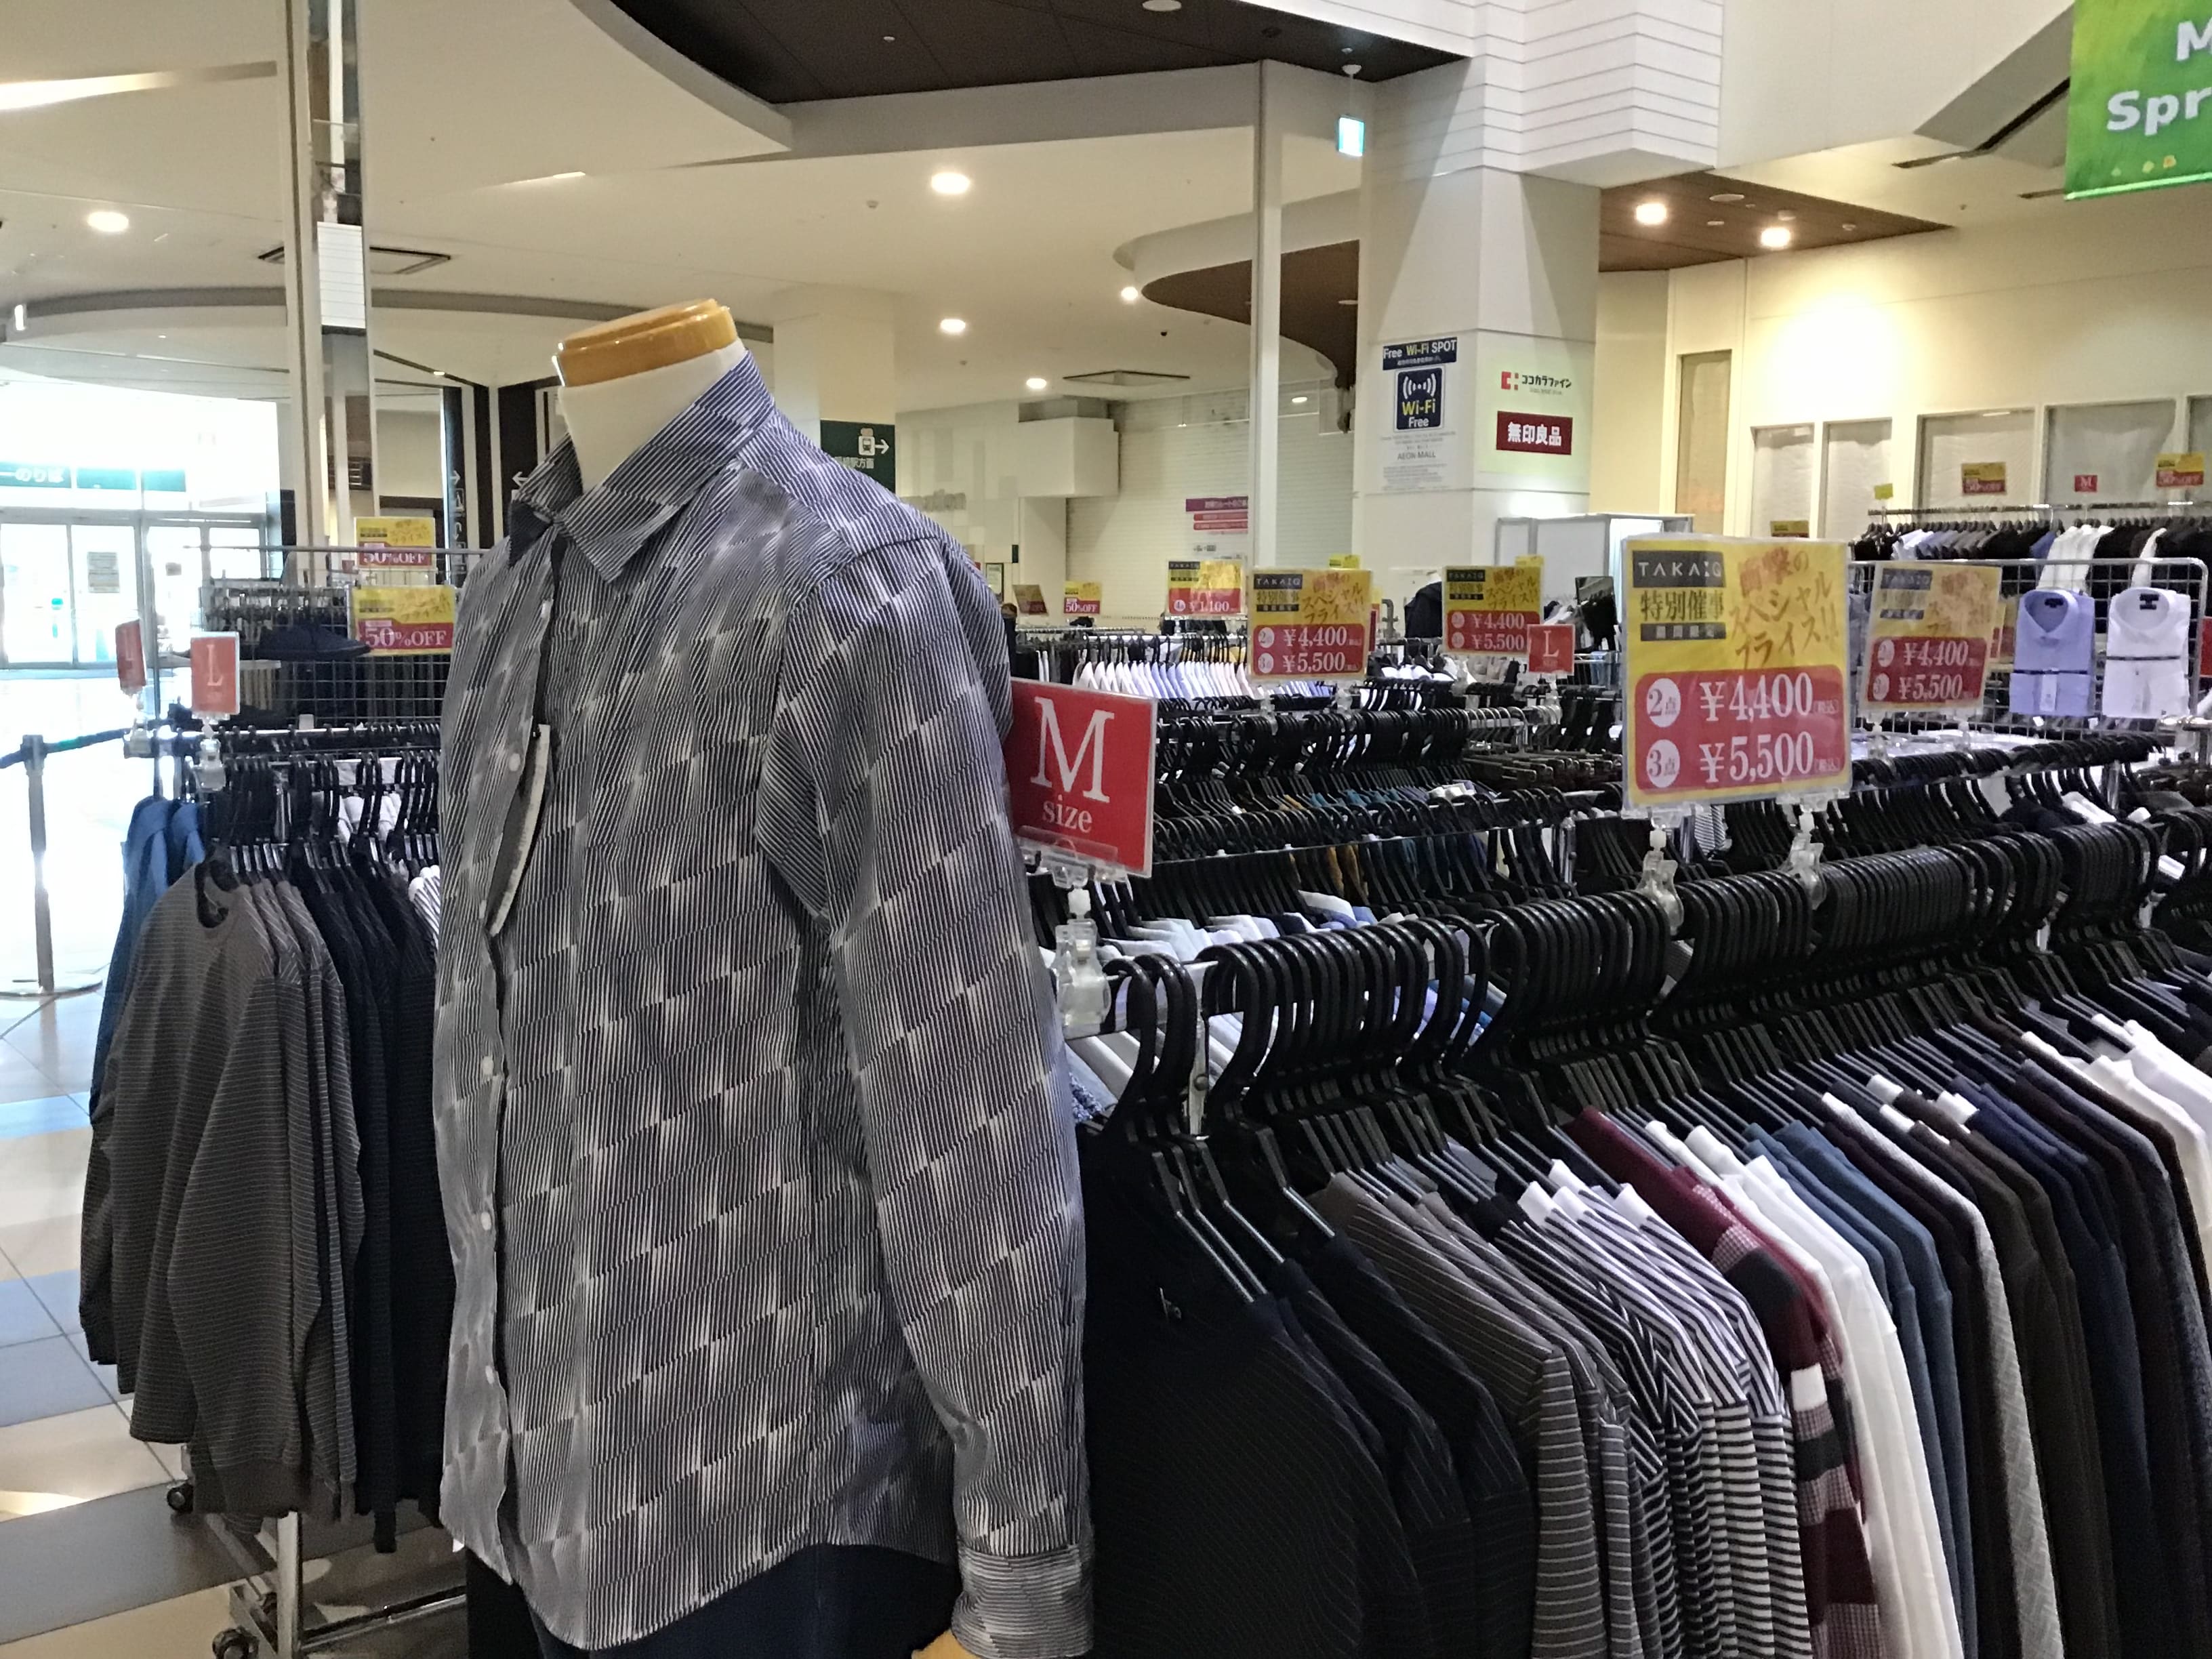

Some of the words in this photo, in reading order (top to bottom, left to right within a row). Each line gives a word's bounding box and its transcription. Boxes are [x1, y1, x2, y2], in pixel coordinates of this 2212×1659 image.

[1383, 348, 1402, 359] Free
[1406, 343, 1429, 356] Wi-Fi
[1432, 340, 1456, 353] SPOT
[1402, 399, 1436, 416] Wi-Fi
[1408, 417, 1429, 428] Free
[1507, 421, 1562, 447] 無印良品
[1418, 451, 1436, 459] MALL
[1640, 590, 1724, 621] 特別催事
[365, 626, 447, 647] 50%OFF
[1543, 630, 1559, 657] L
[206, 644, 224, 687] L
[1699, 672, 1814, 722] ¥4,400
[1030, 696, 1115, 803] M
[1699, 731, 1814, 783] ¥5,500
[1042, 794, 1093, 834] size
